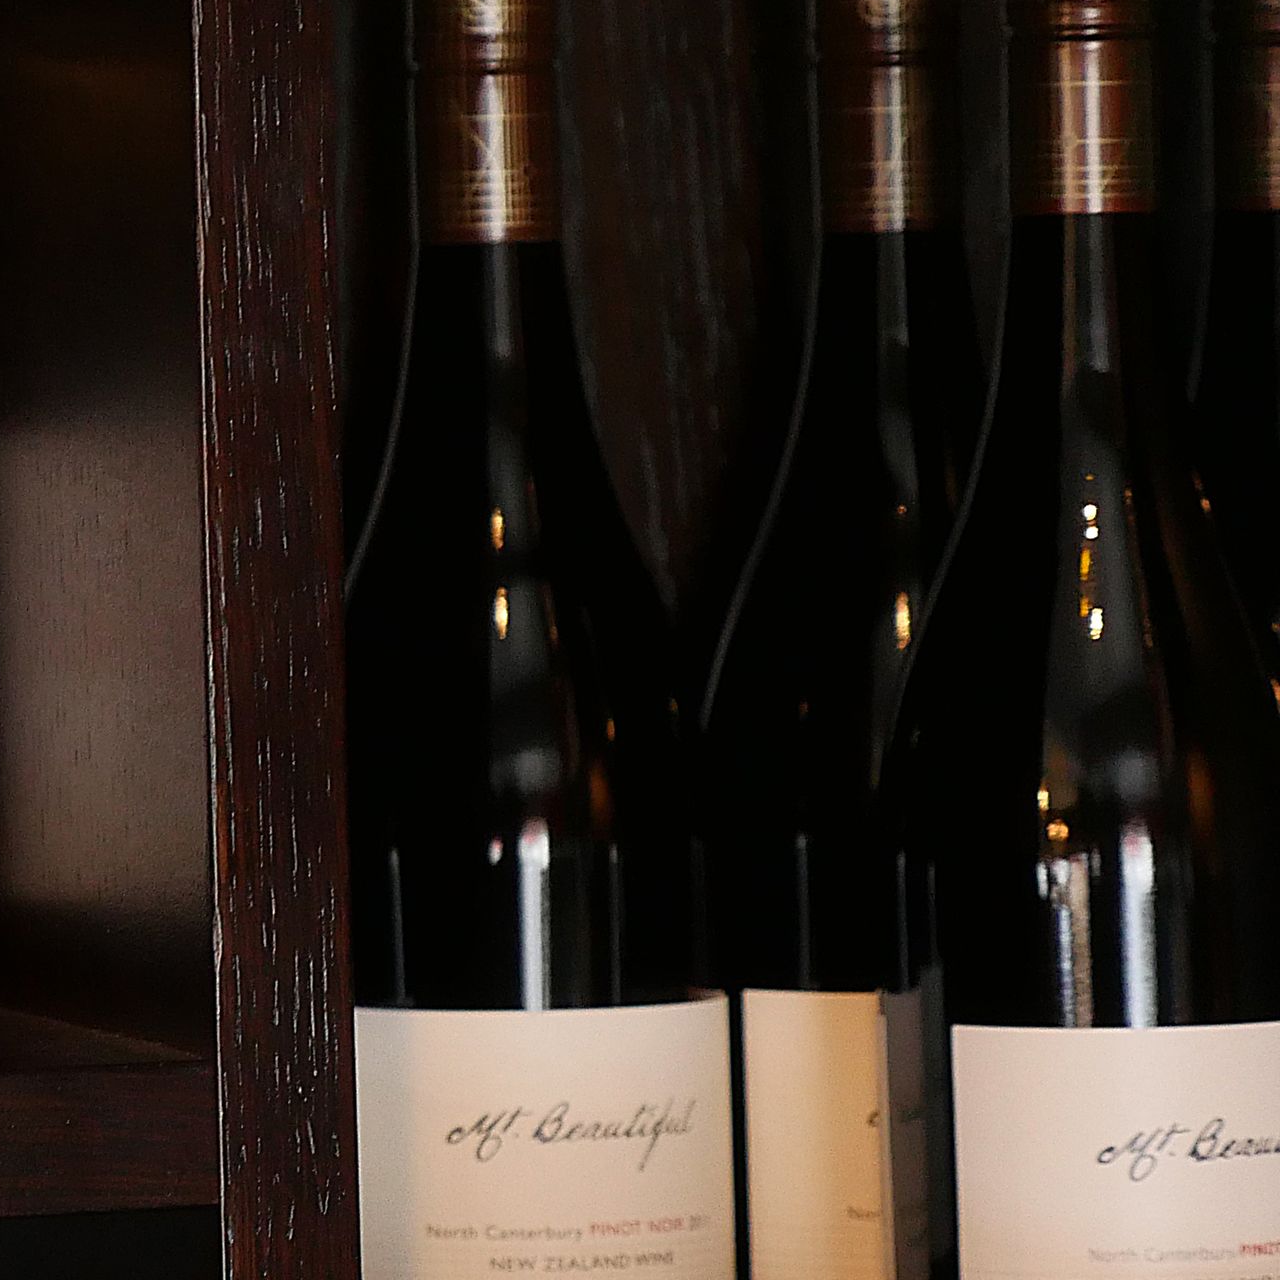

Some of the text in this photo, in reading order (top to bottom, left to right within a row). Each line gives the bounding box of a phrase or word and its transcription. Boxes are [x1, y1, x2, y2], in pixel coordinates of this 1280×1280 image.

[532, 1100, 697, 1172] Beautiful
[425, 1223, 479, 1241] North
[485, 1222, 584, 1243] Canterbury
[590, 1220, 641, 1238] PINOT
[489, 1257, 538, 1271] NEW
[544, 1253, 630, 1271] ZEALAND
